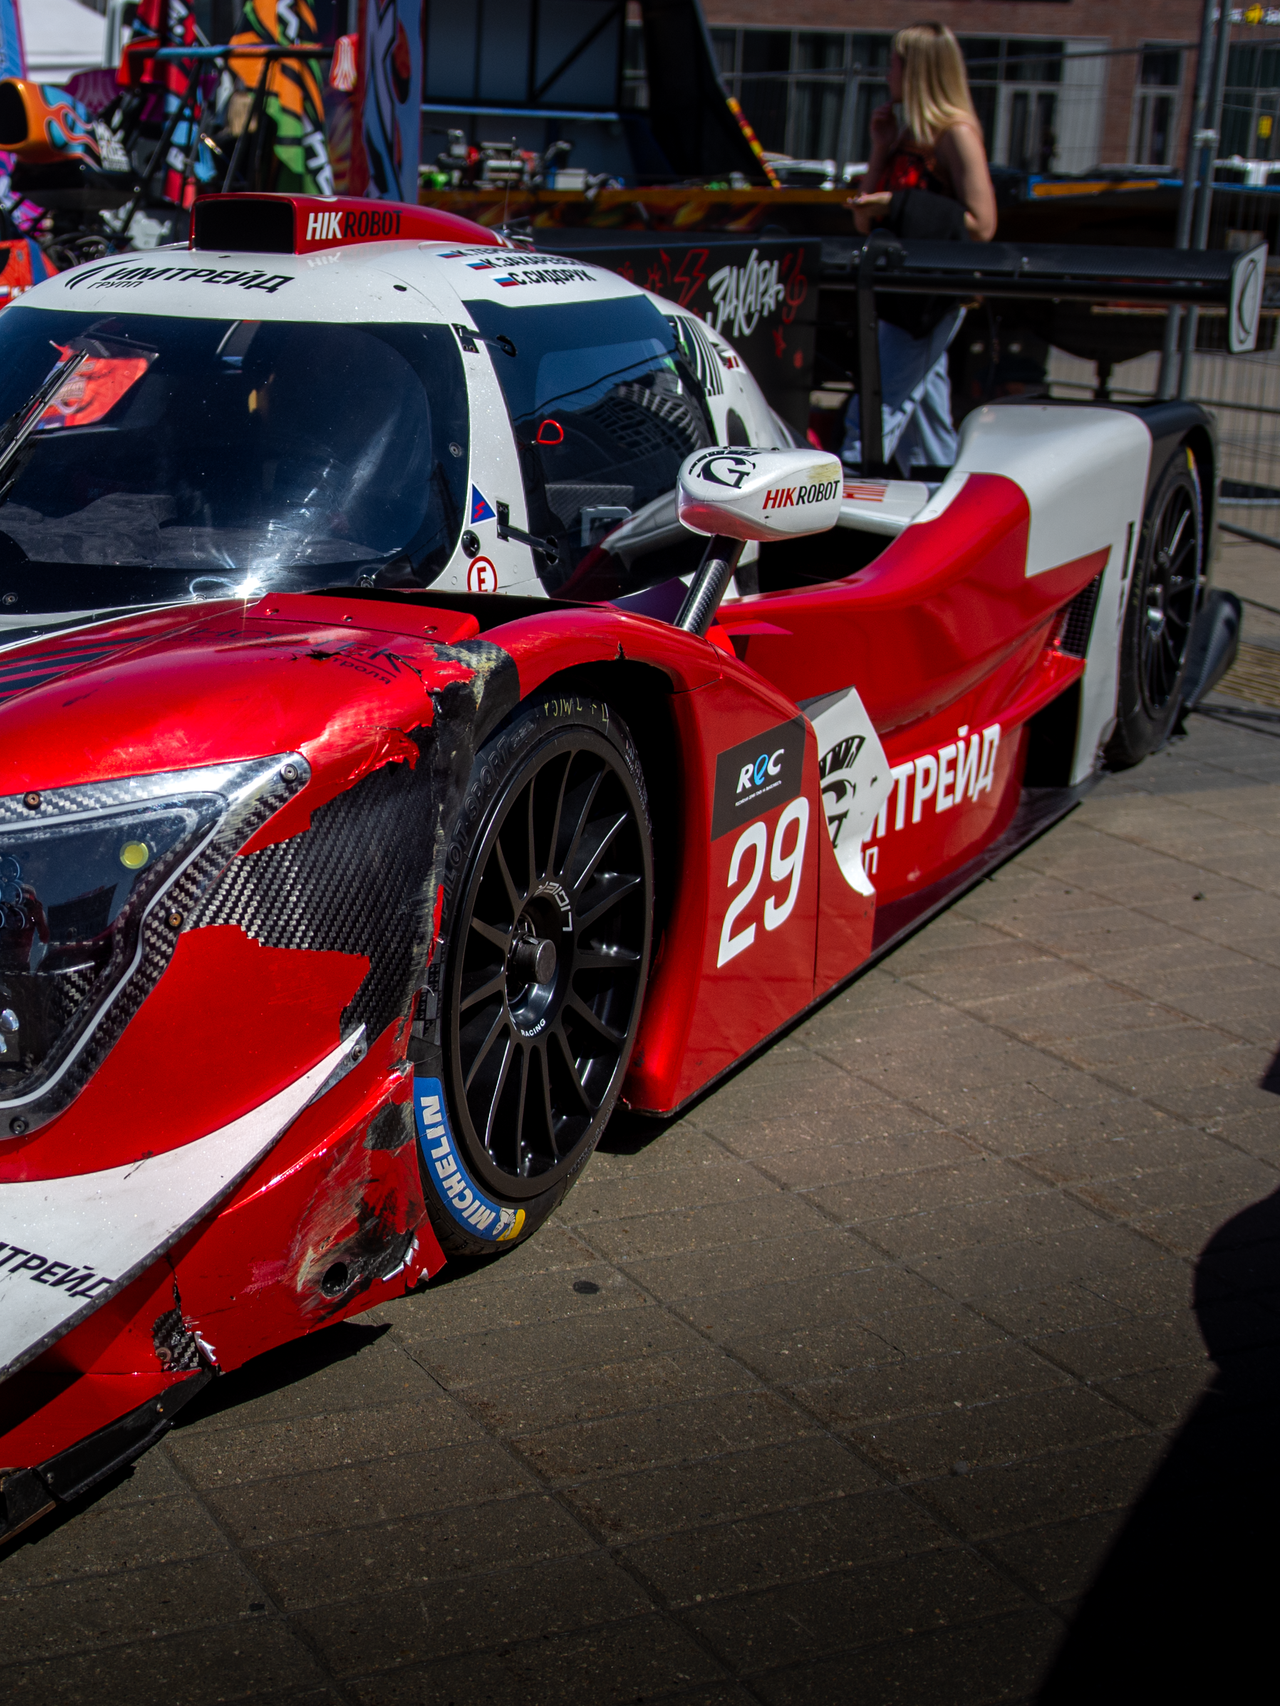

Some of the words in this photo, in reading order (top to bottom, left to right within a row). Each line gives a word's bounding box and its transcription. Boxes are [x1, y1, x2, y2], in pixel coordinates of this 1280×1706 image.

[306, 210, 403, 240] HIKROBOT
[87, 280, 144, 290] ГРУПП
[111, 267, 295, 294] ИМТРЕЙД
[507, 269, 598, 286] С.СИДОРУК
[762, 479, 840, 510] HIKROBOT
[464, 735, 510, 819] SPORT
[862, 723, 1001, 843] ТРЕЙД
[717, 796, 810, 969] 29
[520, 1017, 547, 1038] RACING
[420, 1095, 497, 1231] MICHELIN
